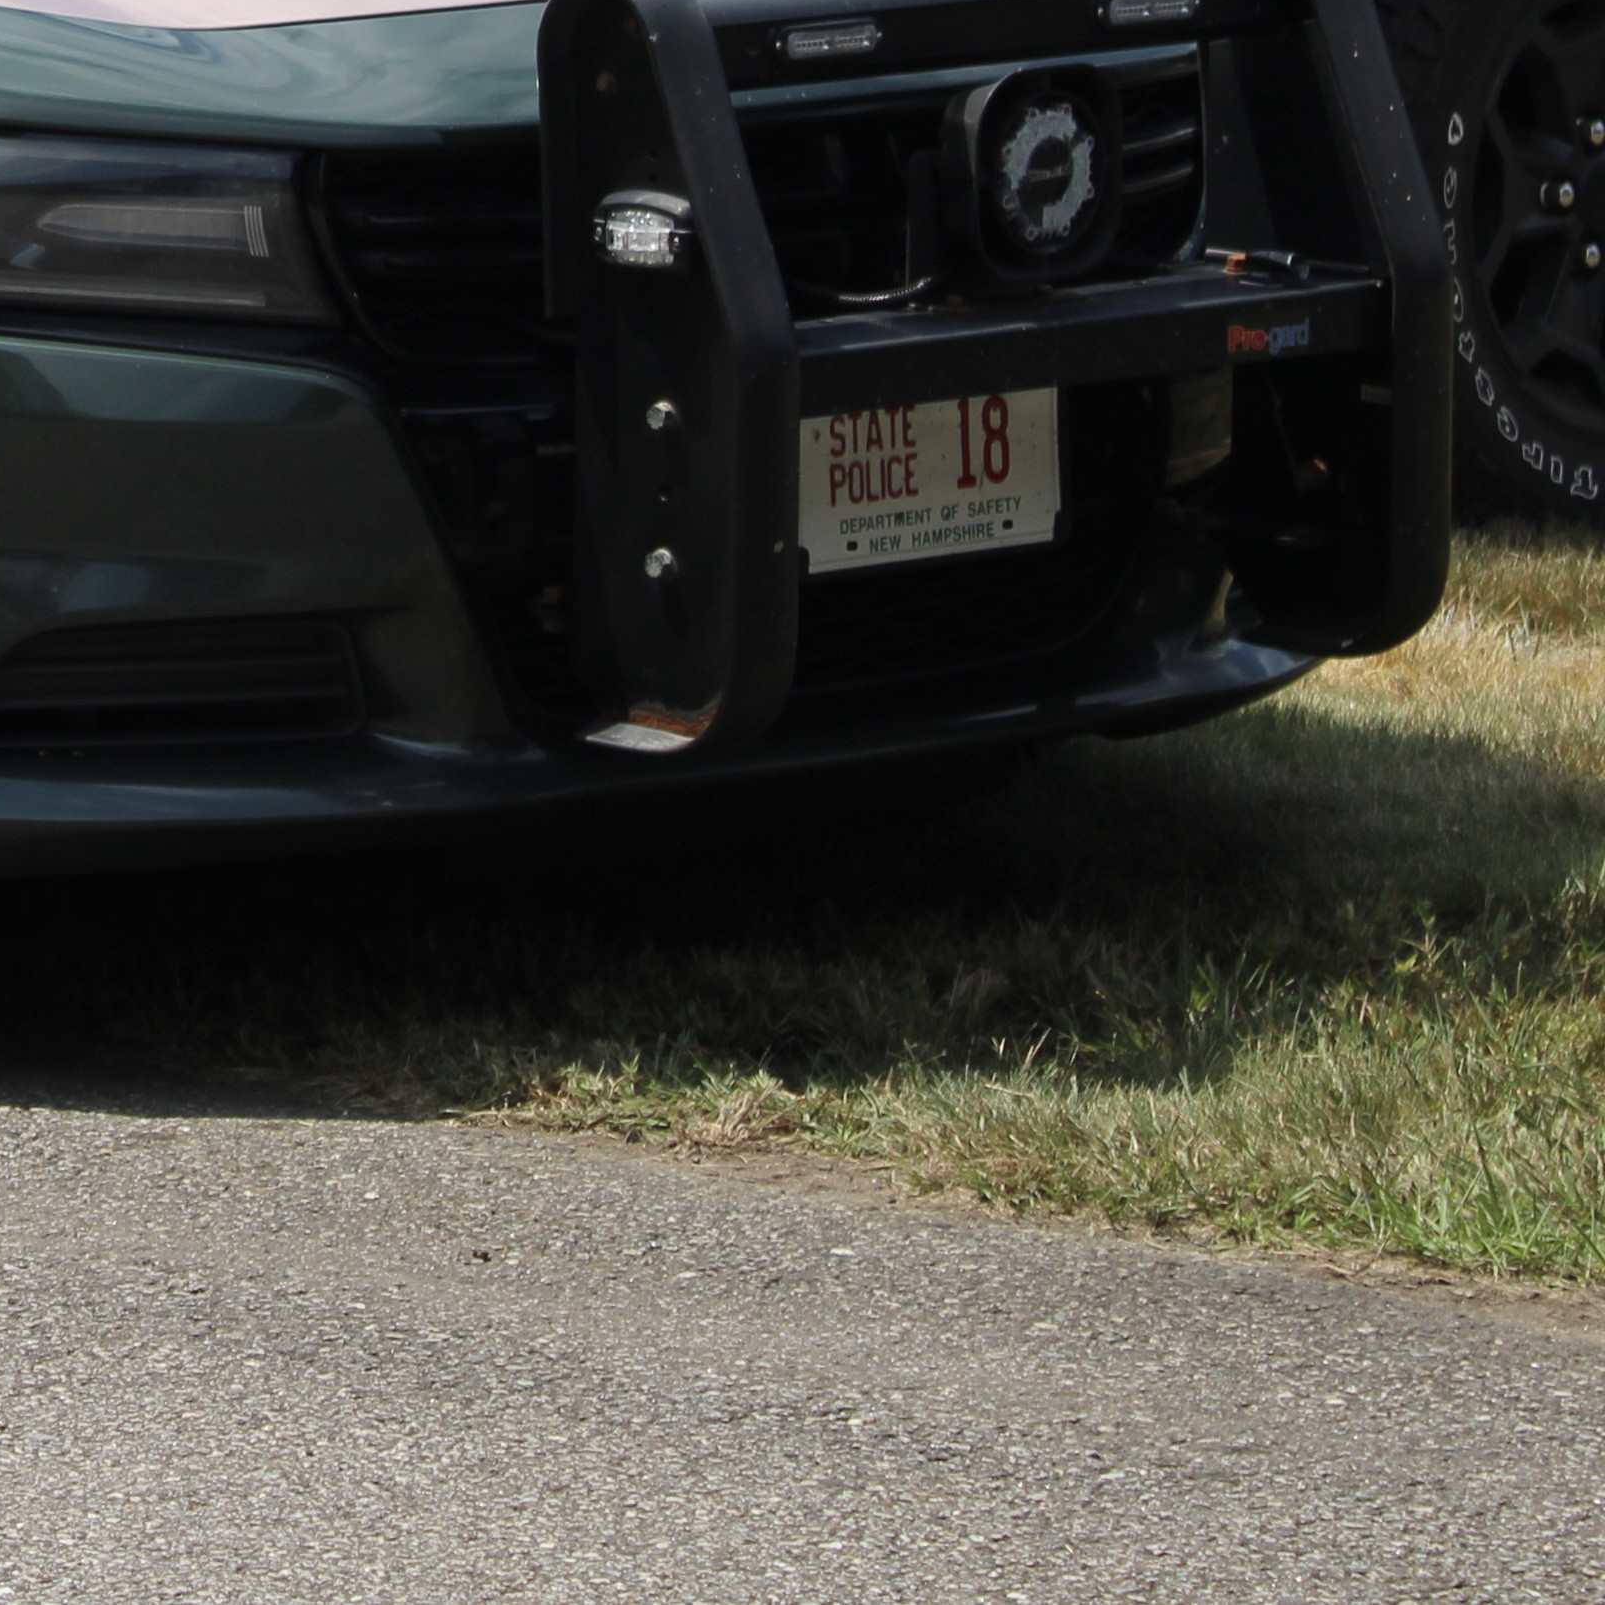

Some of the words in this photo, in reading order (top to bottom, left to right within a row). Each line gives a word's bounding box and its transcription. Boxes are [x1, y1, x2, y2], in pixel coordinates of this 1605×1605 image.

[829, 405, 917, 458] STATE
[957, 395, 1010, 488] 18
[829, 453, 919, 508] POLICE
[839, 506, 933, 536] DEPARTMENT
[939, 502, 960, 522] OF
[967, 496, 1023, 520] SAFETY
[868, 534, 902, 554] NEW
[911, 521, 995, 548] HAMPSHIRE
